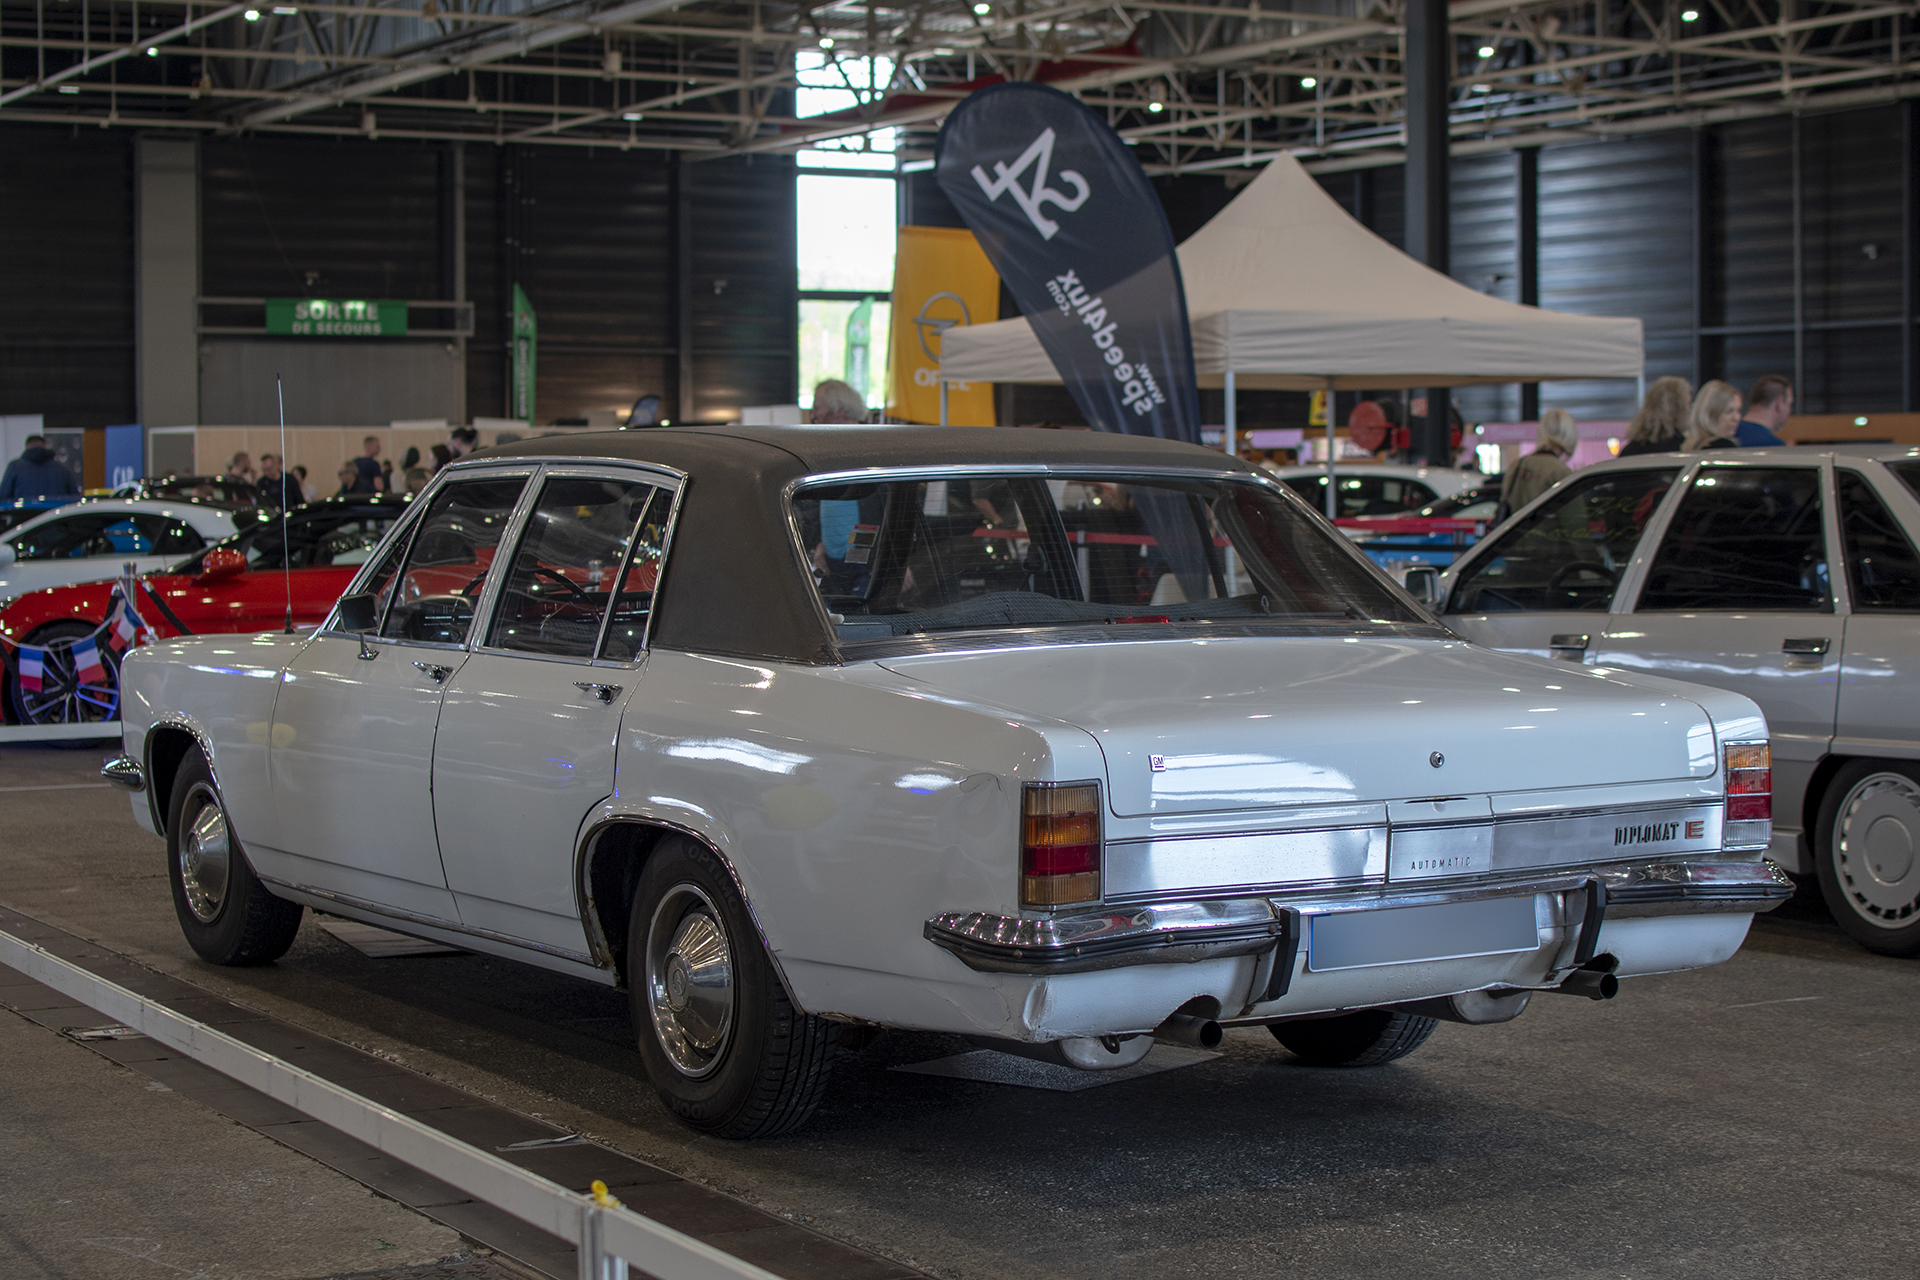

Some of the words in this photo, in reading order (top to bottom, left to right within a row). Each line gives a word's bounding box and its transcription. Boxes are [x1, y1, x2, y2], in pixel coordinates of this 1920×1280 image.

[295, 301, 379, 320] SORTIE
[292, 322, 311, 335] DE
[316, 322, 382, 335] SECOURS
[1614, 822, 1679, 846] DIPLOMAT
[1684, 820, 1704, 839] E
[1410, 857, 1471, 870] AUTOMATIC
[688, 845, 740, 914] OPTIMO
